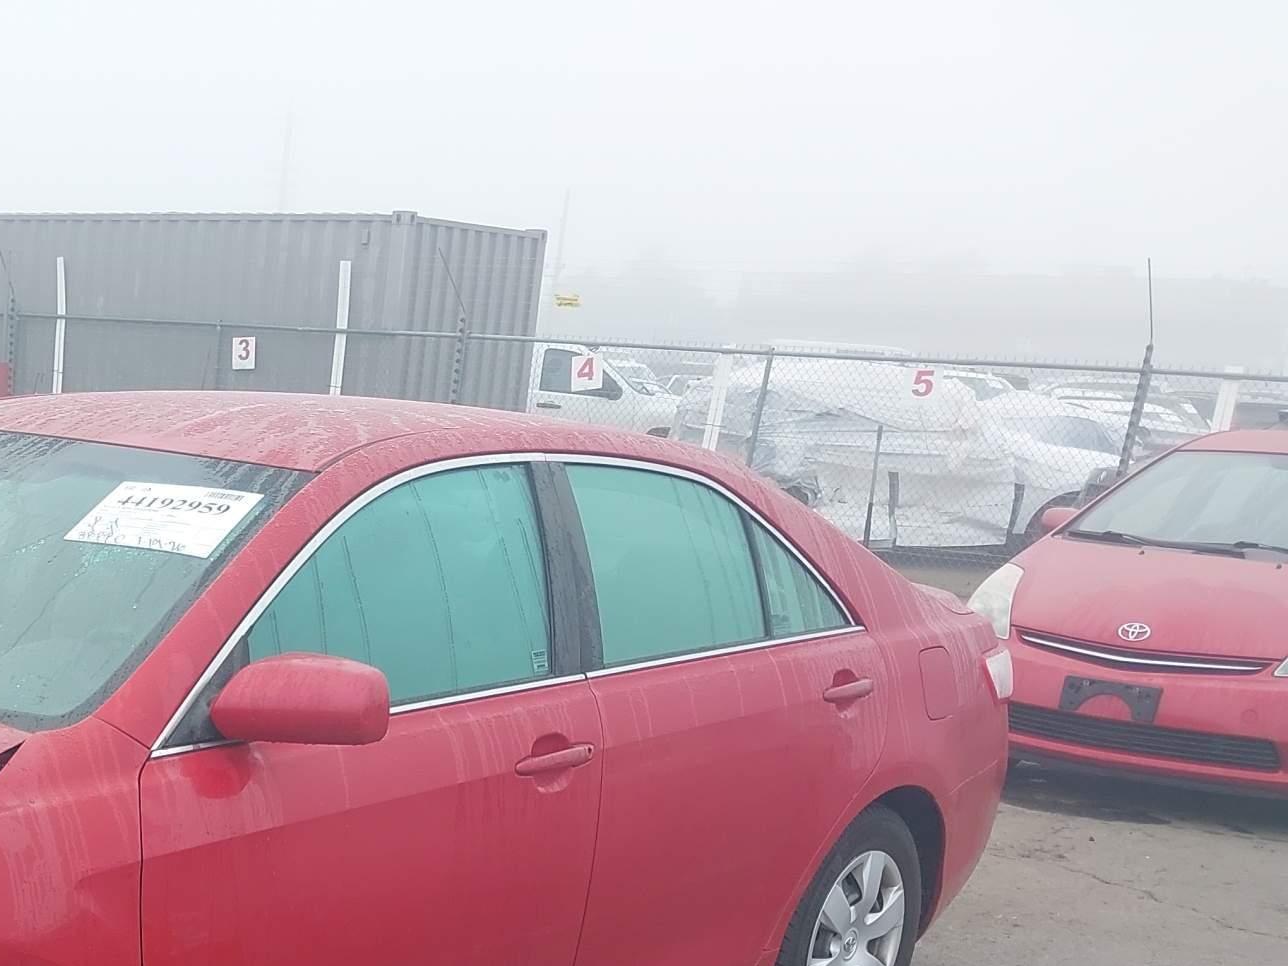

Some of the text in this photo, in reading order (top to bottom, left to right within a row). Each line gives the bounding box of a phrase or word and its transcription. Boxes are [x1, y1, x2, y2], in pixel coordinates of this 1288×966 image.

[238, 339, 250, 360] 3
[577, 357, 594, 380] 4
[912, 370, 935, 397] 5
[117, 495, 231, 516] 44192959
